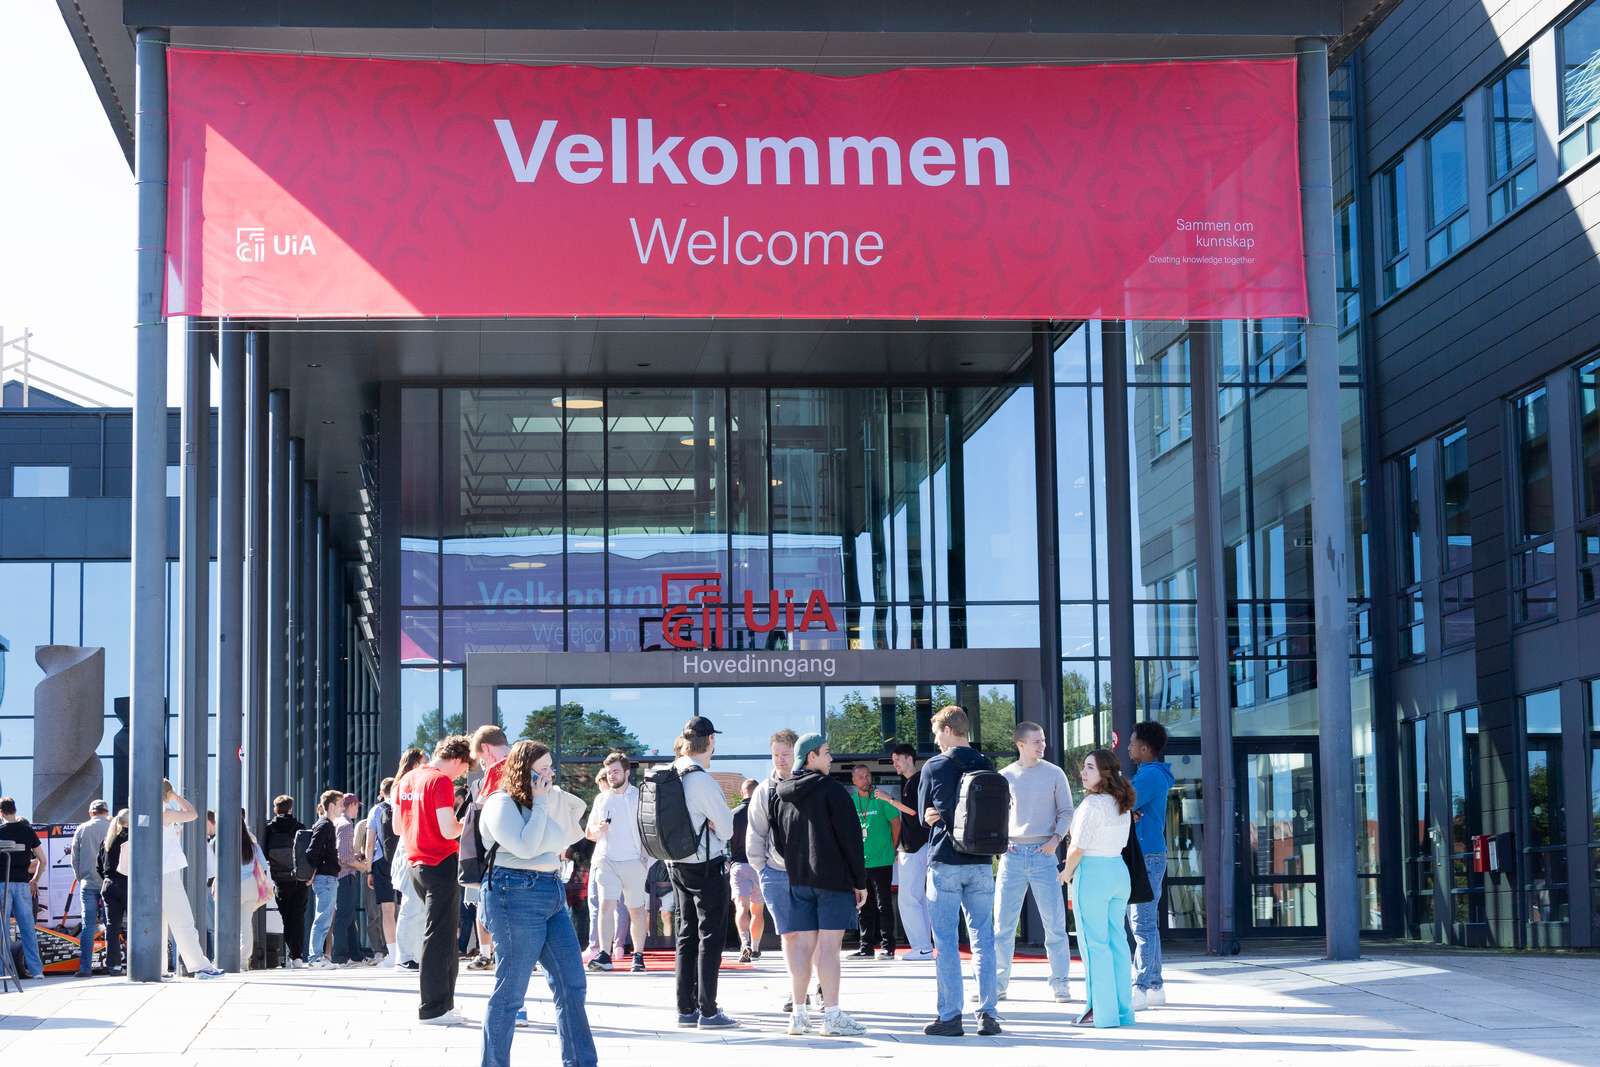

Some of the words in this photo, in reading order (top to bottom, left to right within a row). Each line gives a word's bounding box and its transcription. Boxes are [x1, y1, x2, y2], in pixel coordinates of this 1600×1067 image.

[493, 118, 1010, 187] Velkommen
[1176, 218, 1230, 232] Sammen
[1234, 222, 1254, 232] om
[273, 234, 317, 256] UiA
[629, 216, 884, 267] Welcome
[1196, 235, 1255, 250] kunnskap
[1148, 255, 1181, 266] Creating
[1182, 255, 1223, 266] knowledge
[1224, 256, 1255, 267] together
[743, 588, 838, 633] UiA
[682, 654, 837, 678] Hovedinngang
